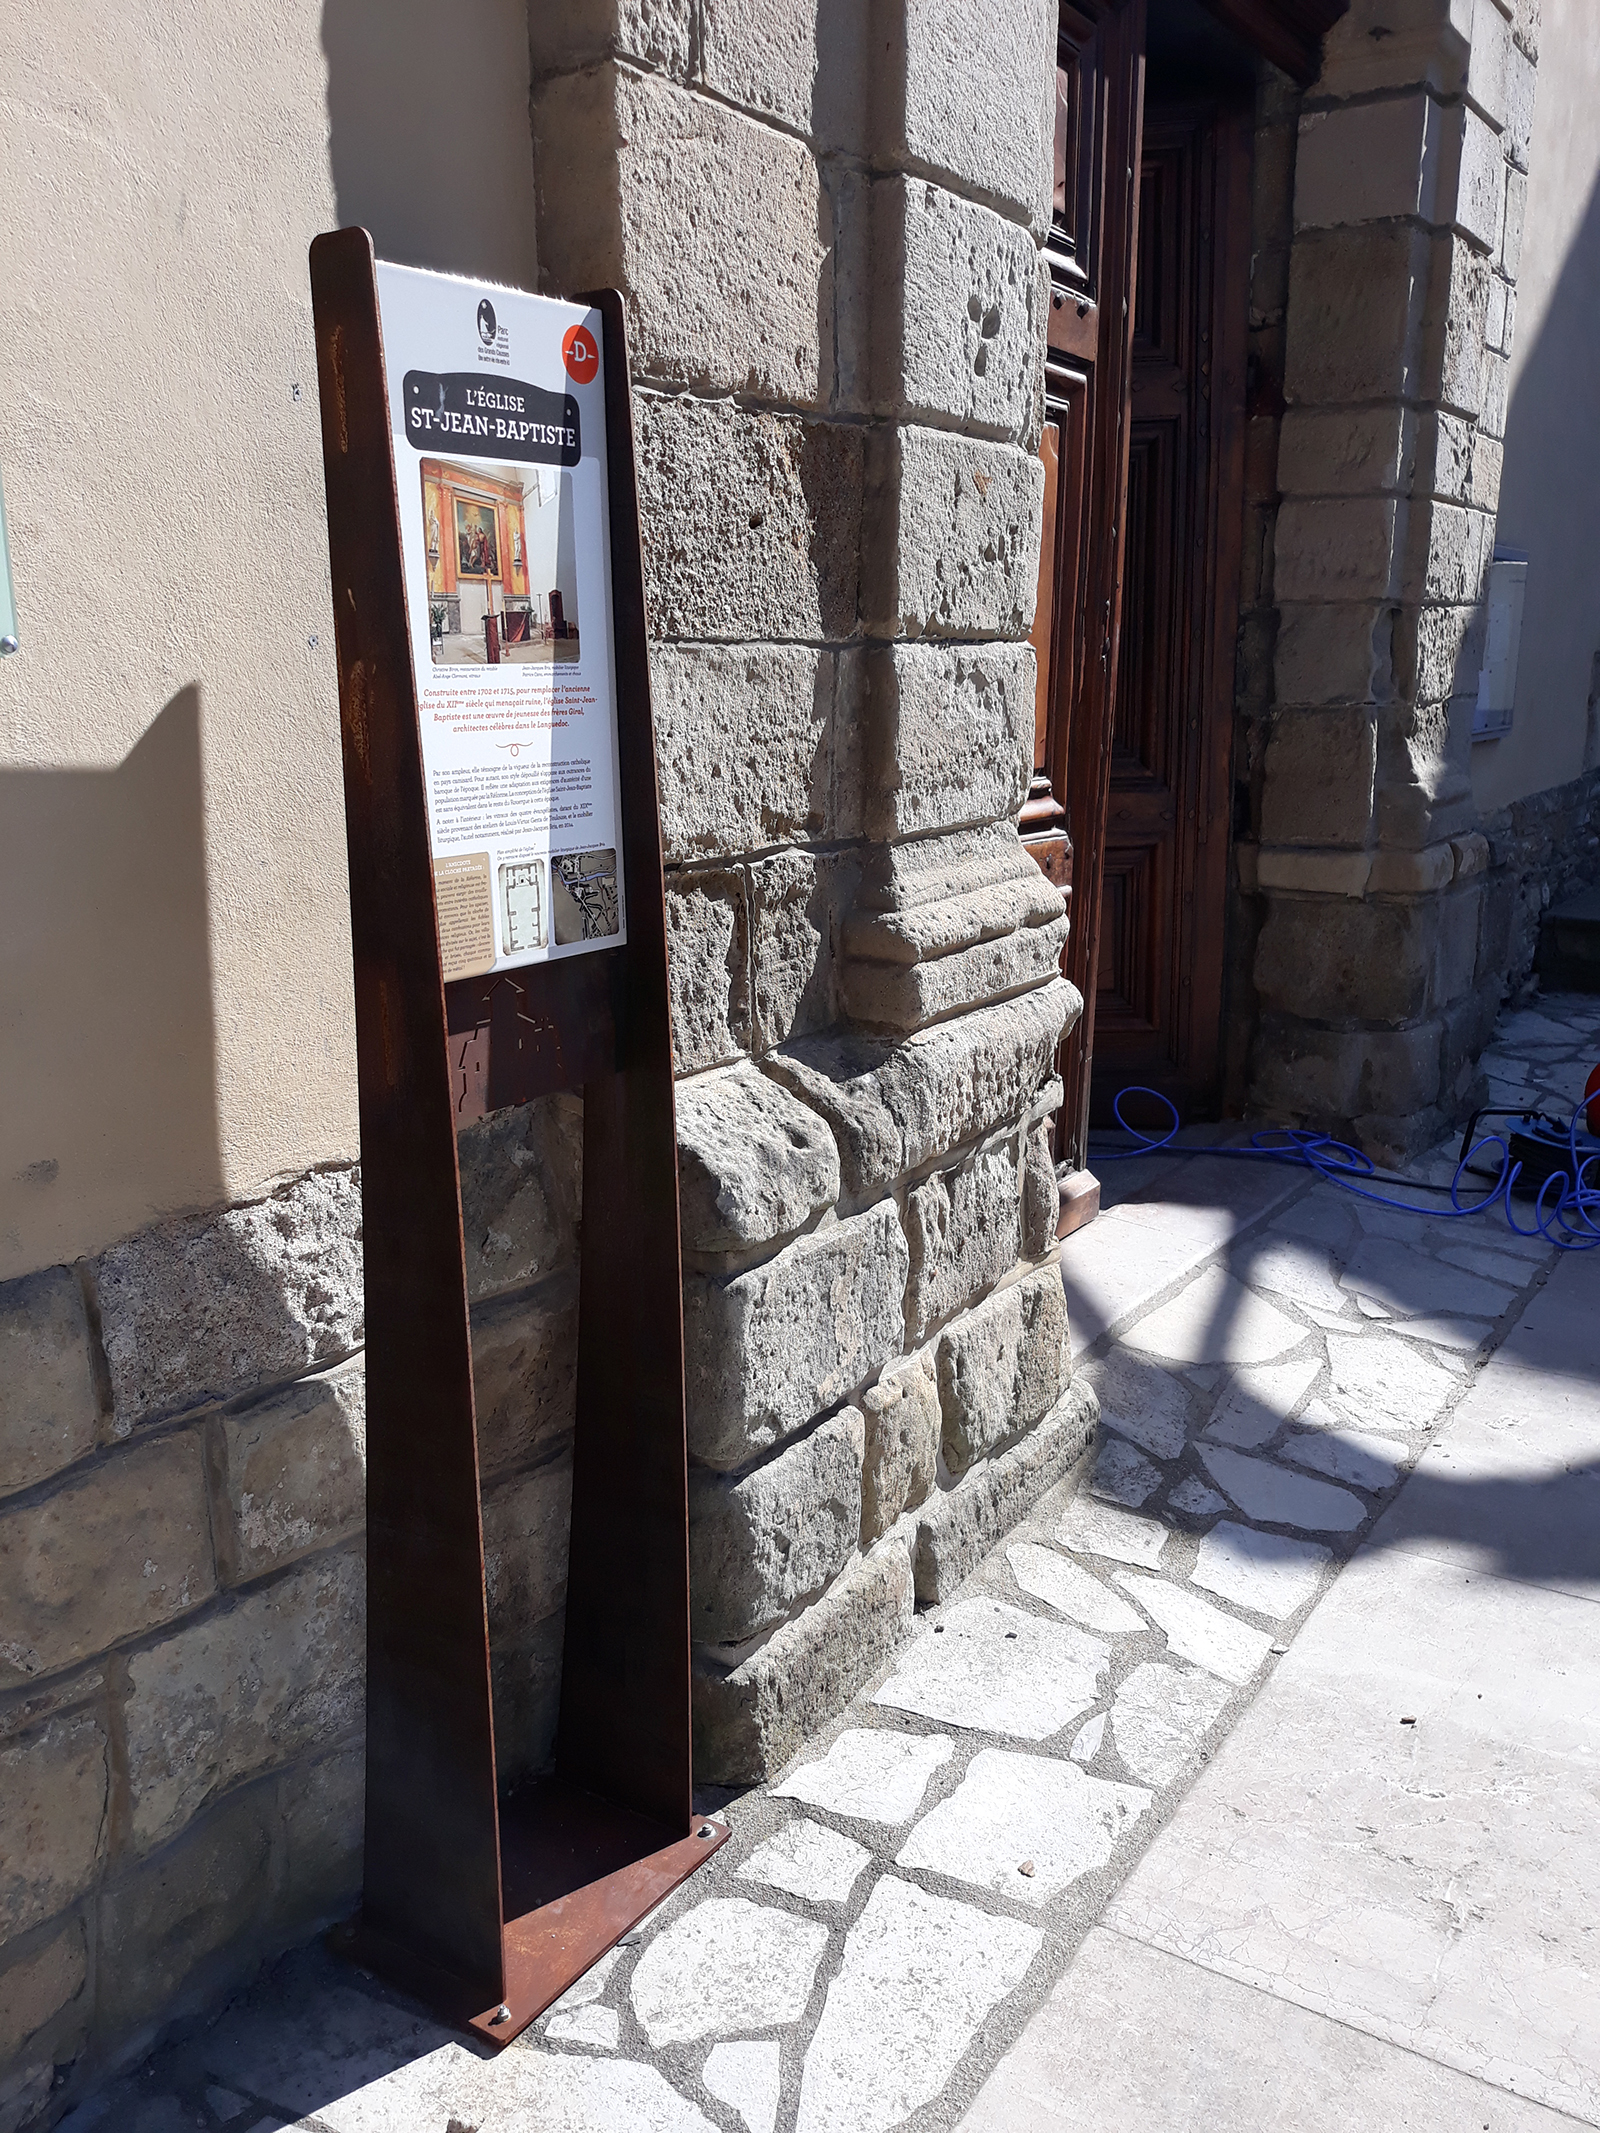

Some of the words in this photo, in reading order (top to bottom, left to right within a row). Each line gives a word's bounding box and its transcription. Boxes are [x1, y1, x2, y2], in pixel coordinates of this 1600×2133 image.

[498, 325, 509, 335] Parc
[466, 386, 525, 413] L'ÉGLISE
[411, 407, 576, 447] ST-JEAN-BAPTISTE
[531, 685, 560, 695] remplacer
[418, 700, 435, 711] glise
[436, 700, 445, 708] du
[466, 699, 483, 707] siècle
[484, 700, 494, 708] qui
[496, 698, 524, 707] menaçait
[544, 696, 564, 706] l'église
[565, 696, 598, 704] Saint-Jean-
[434, 713, 460, 723] Baptiste
[514, 710, 539, 719] jeunesse
[552, 707, 568, 715] frères
[453, 724, 488, 733] architectes
[489, 722, 514, 731] célèbres
[515, 721, 529, 729] dans
[537, 719, 569, 729] Languedoc.
